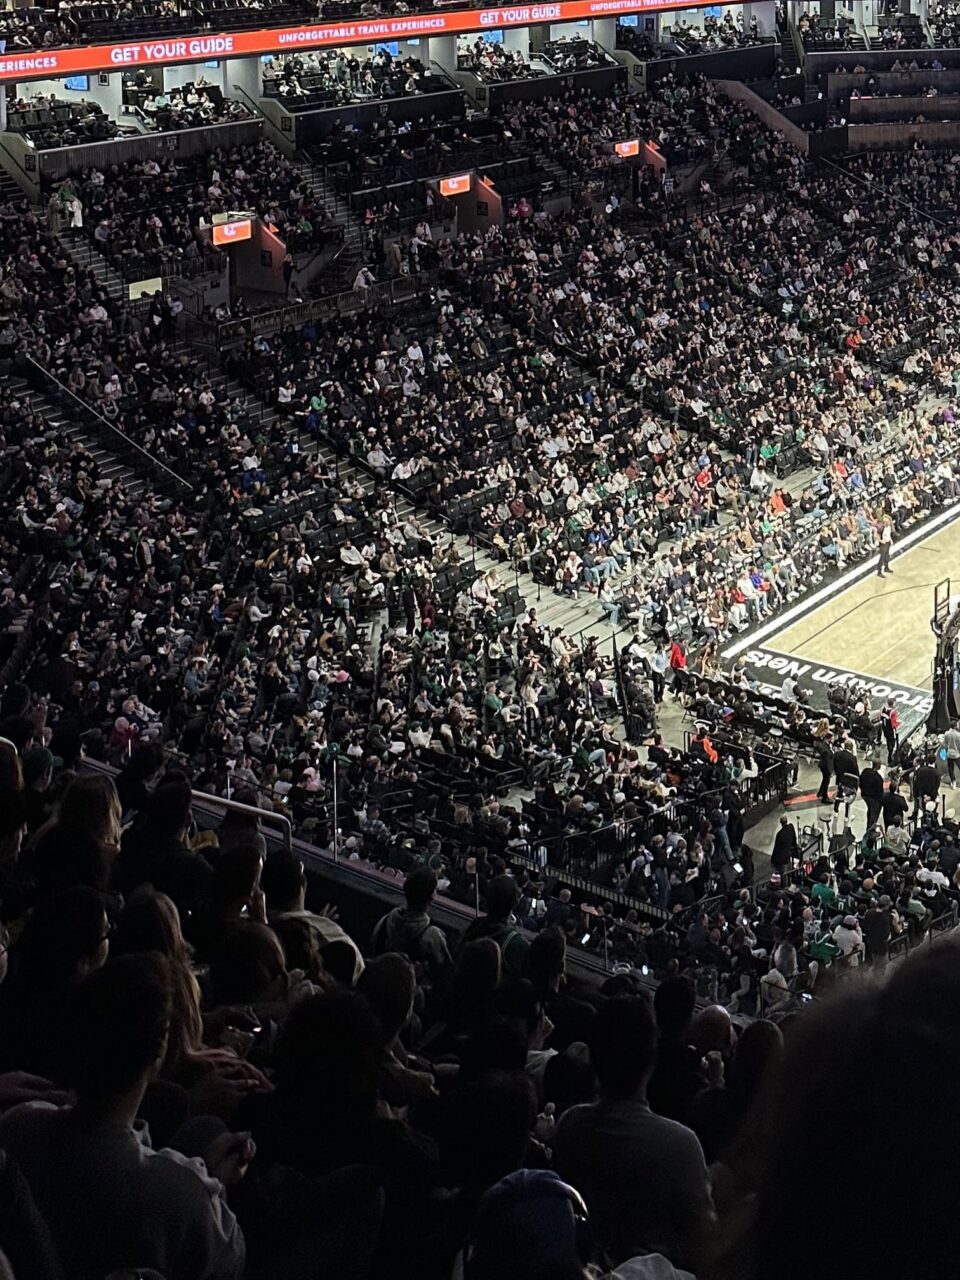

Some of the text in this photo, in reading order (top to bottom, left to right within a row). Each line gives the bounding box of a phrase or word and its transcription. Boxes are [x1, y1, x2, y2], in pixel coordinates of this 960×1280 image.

[111, 47, 139, 63] GET
[141, 42, 187, 60] YOUR
[189, 38, 234, 55] GUIDE
[278, 29, 355, 44] UNFORGETTABLE
[357, 23, 390, 36] TRAVEL
[391, 18, 446, 32] EXPERIENCES
[480, 12, 501, 25] GET
[501, 9, 531, 23] YOUR
[532, 6, 561, 19] GUIDE
[590, 0, 642, 12] UNFORGETTABLE
[744, 650, 811, 677] Nets
